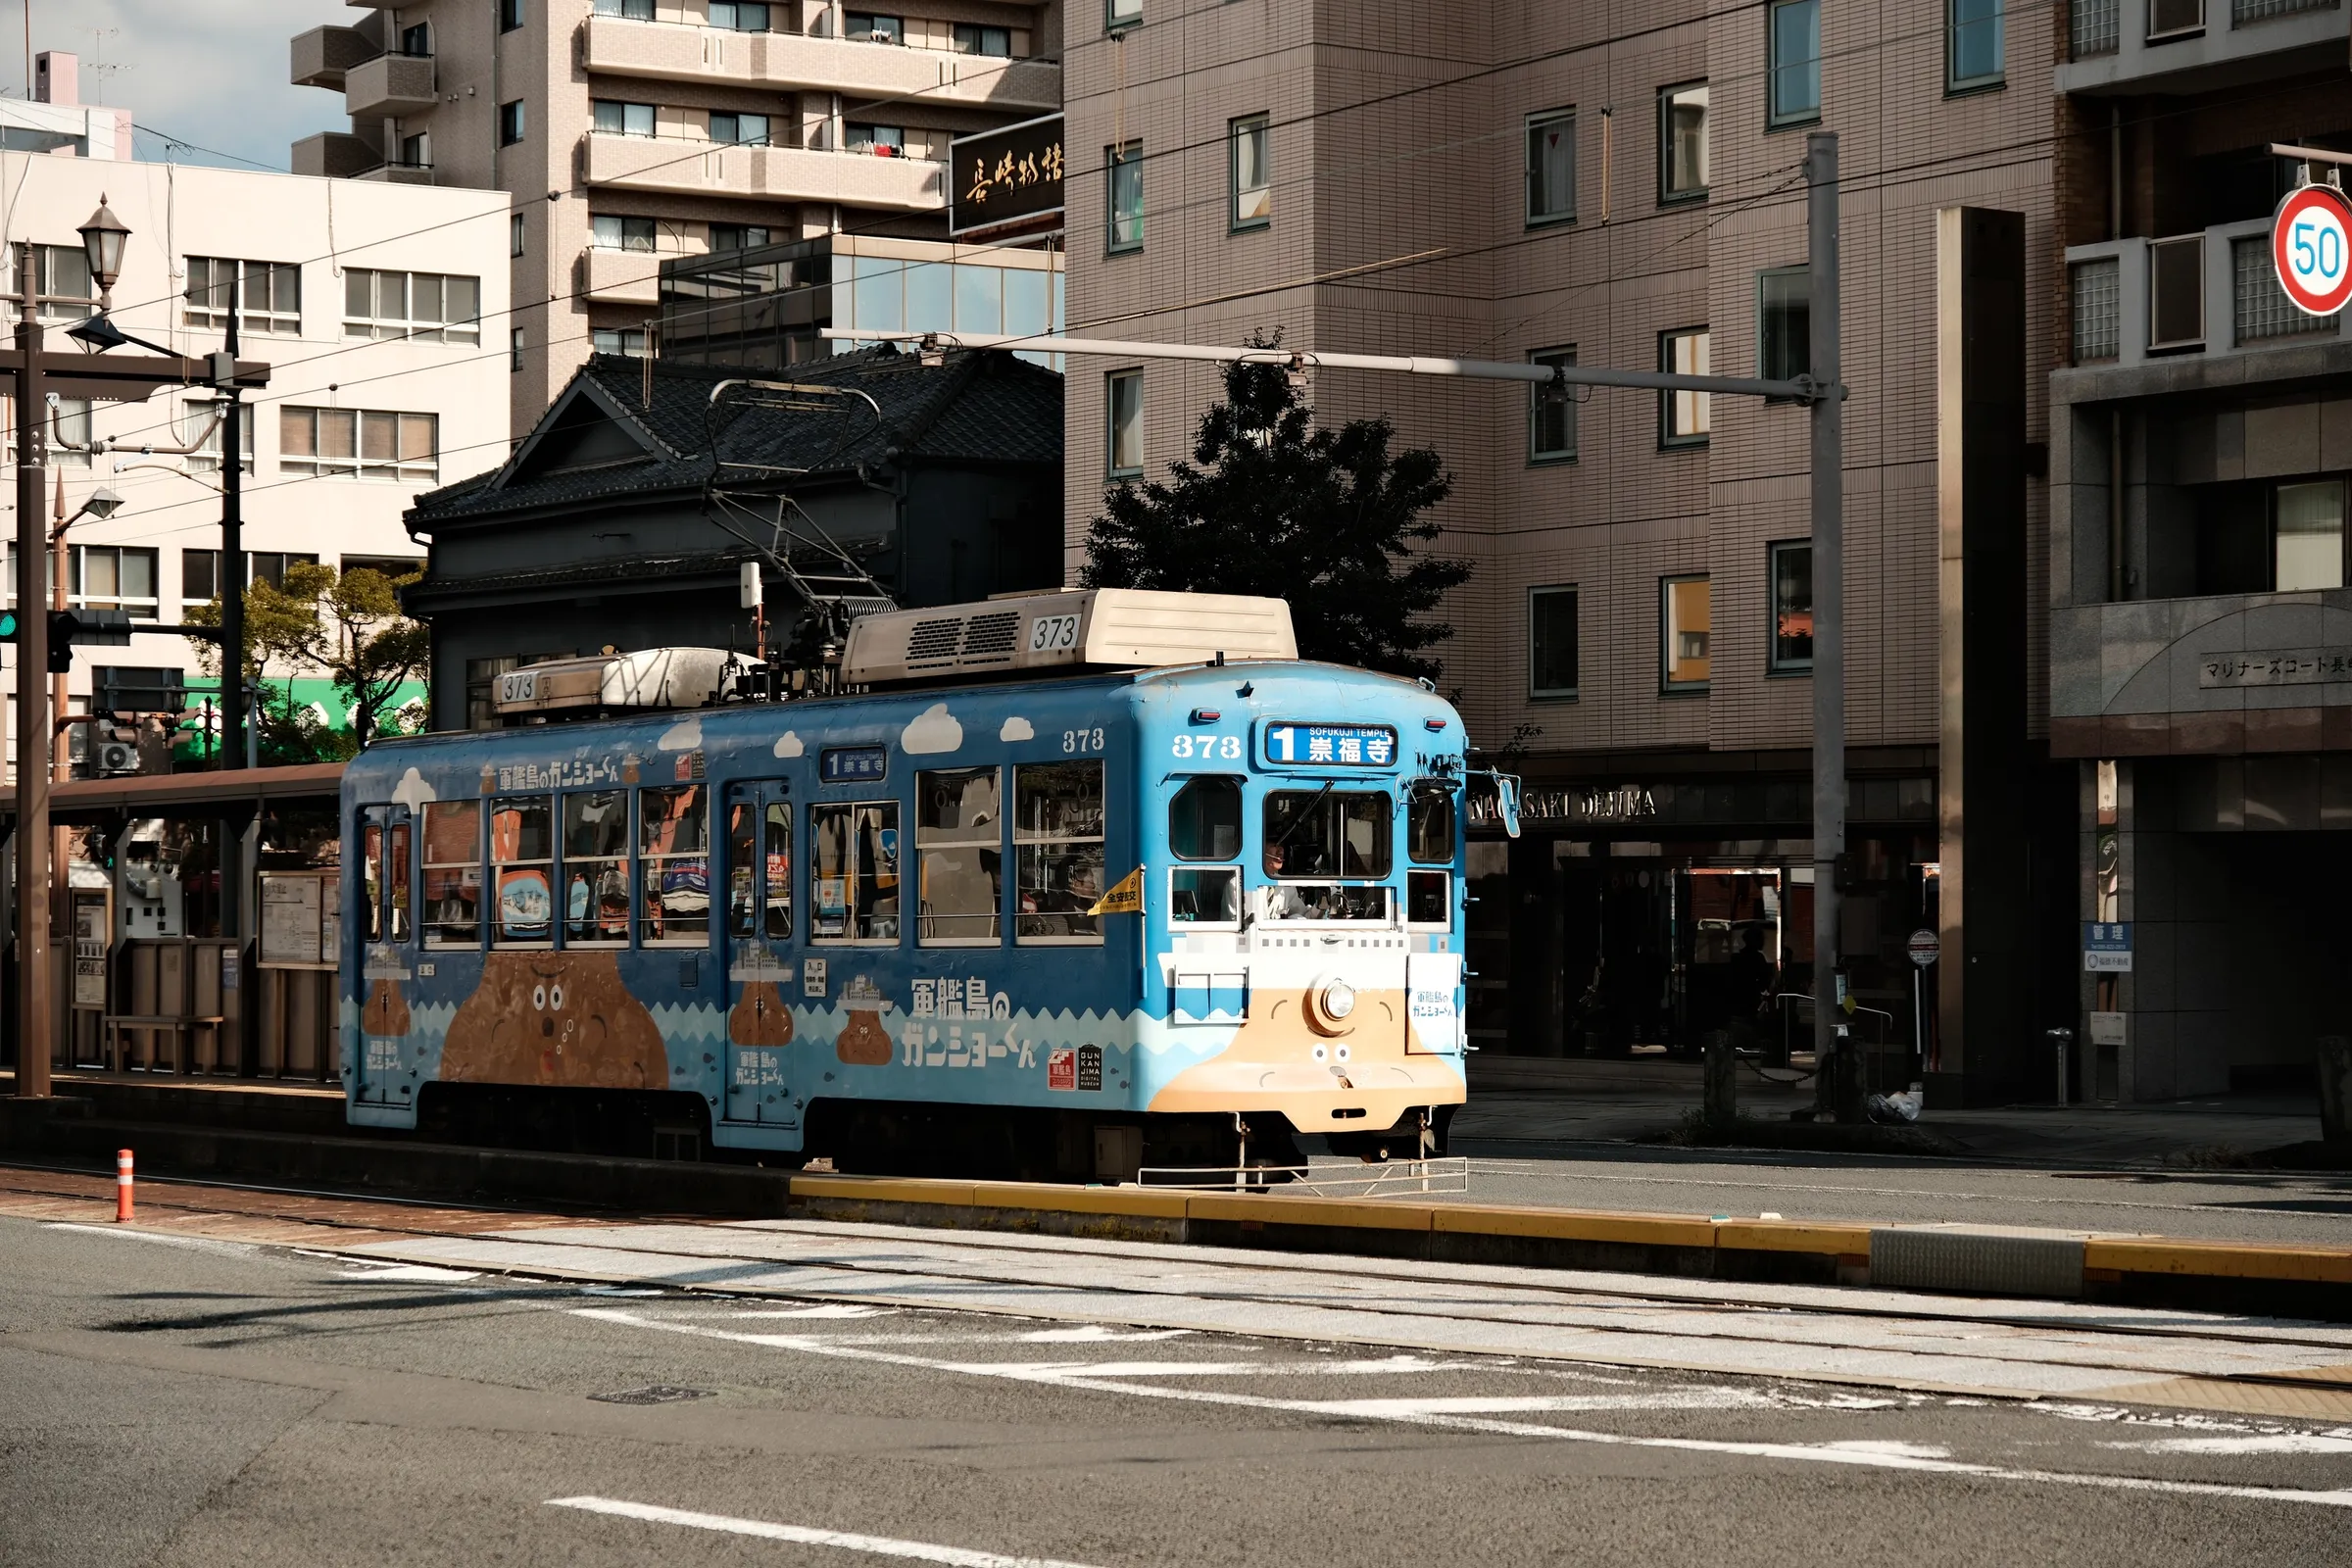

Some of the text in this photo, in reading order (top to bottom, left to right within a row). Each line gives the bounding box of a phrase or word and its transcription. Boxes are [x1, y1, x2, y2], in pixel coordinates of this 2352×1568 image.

[2295, 221, 2340, 278] 50
[1034, 616, 1076, 650] 373
[2206, 656, 2352, 678] マリナーズコート長
[505, 674, 532, 700] 373
[1062, 727, 1104, 753] 373
[1273, 727, 1295, 760] 1
[1309, 727, 1390, 737] SOFUKUJI TEMPLE
[1172, 735, 1242, 759] 373
[1309, 737, 1390, 762] 崇福寺
[829, 754, 838, 775] 1
[844, 760, 884, 772] 崇福寺
[1582, 790, 1656, 816] DEJIMA
[2093, 925, 2124, 940] 管理
[911, 976, 1010, 1021] 軍艦島の
[902, 1022, 1036, 1068] ガンショーくん
